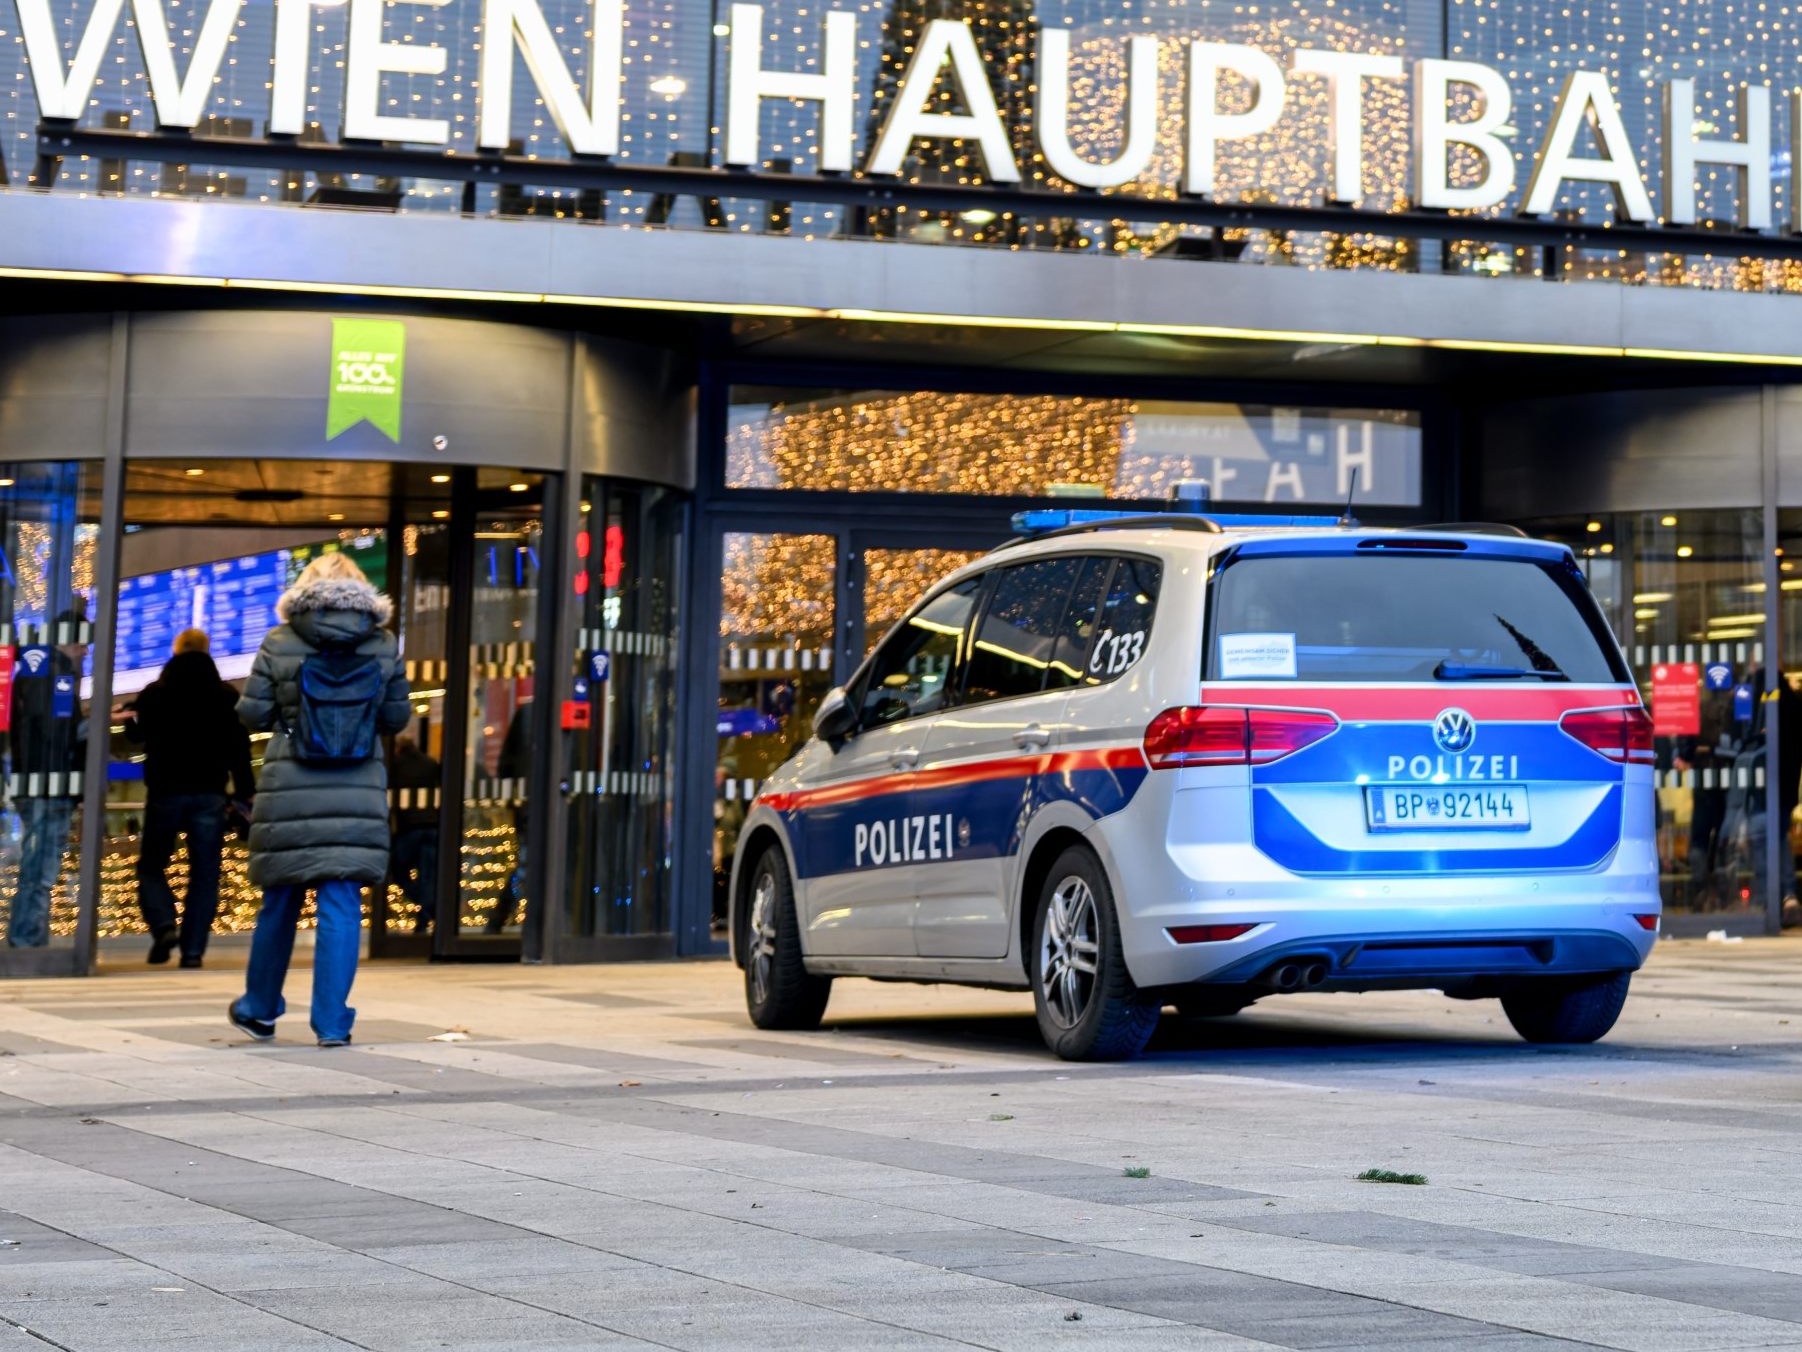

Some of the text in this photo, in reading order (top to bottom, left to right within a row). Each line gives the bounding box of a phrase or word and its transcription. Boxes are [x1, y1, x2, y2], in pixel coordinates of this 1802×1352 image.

[1106, 630, 1146, 675] 133
[1387, 754, 1519, 780] POLIZEI
[1395, 792, 1423, 819] BP
[1443, 792, 1514, 819] 92144
[855, 813, 953, 867] POLIZEI
